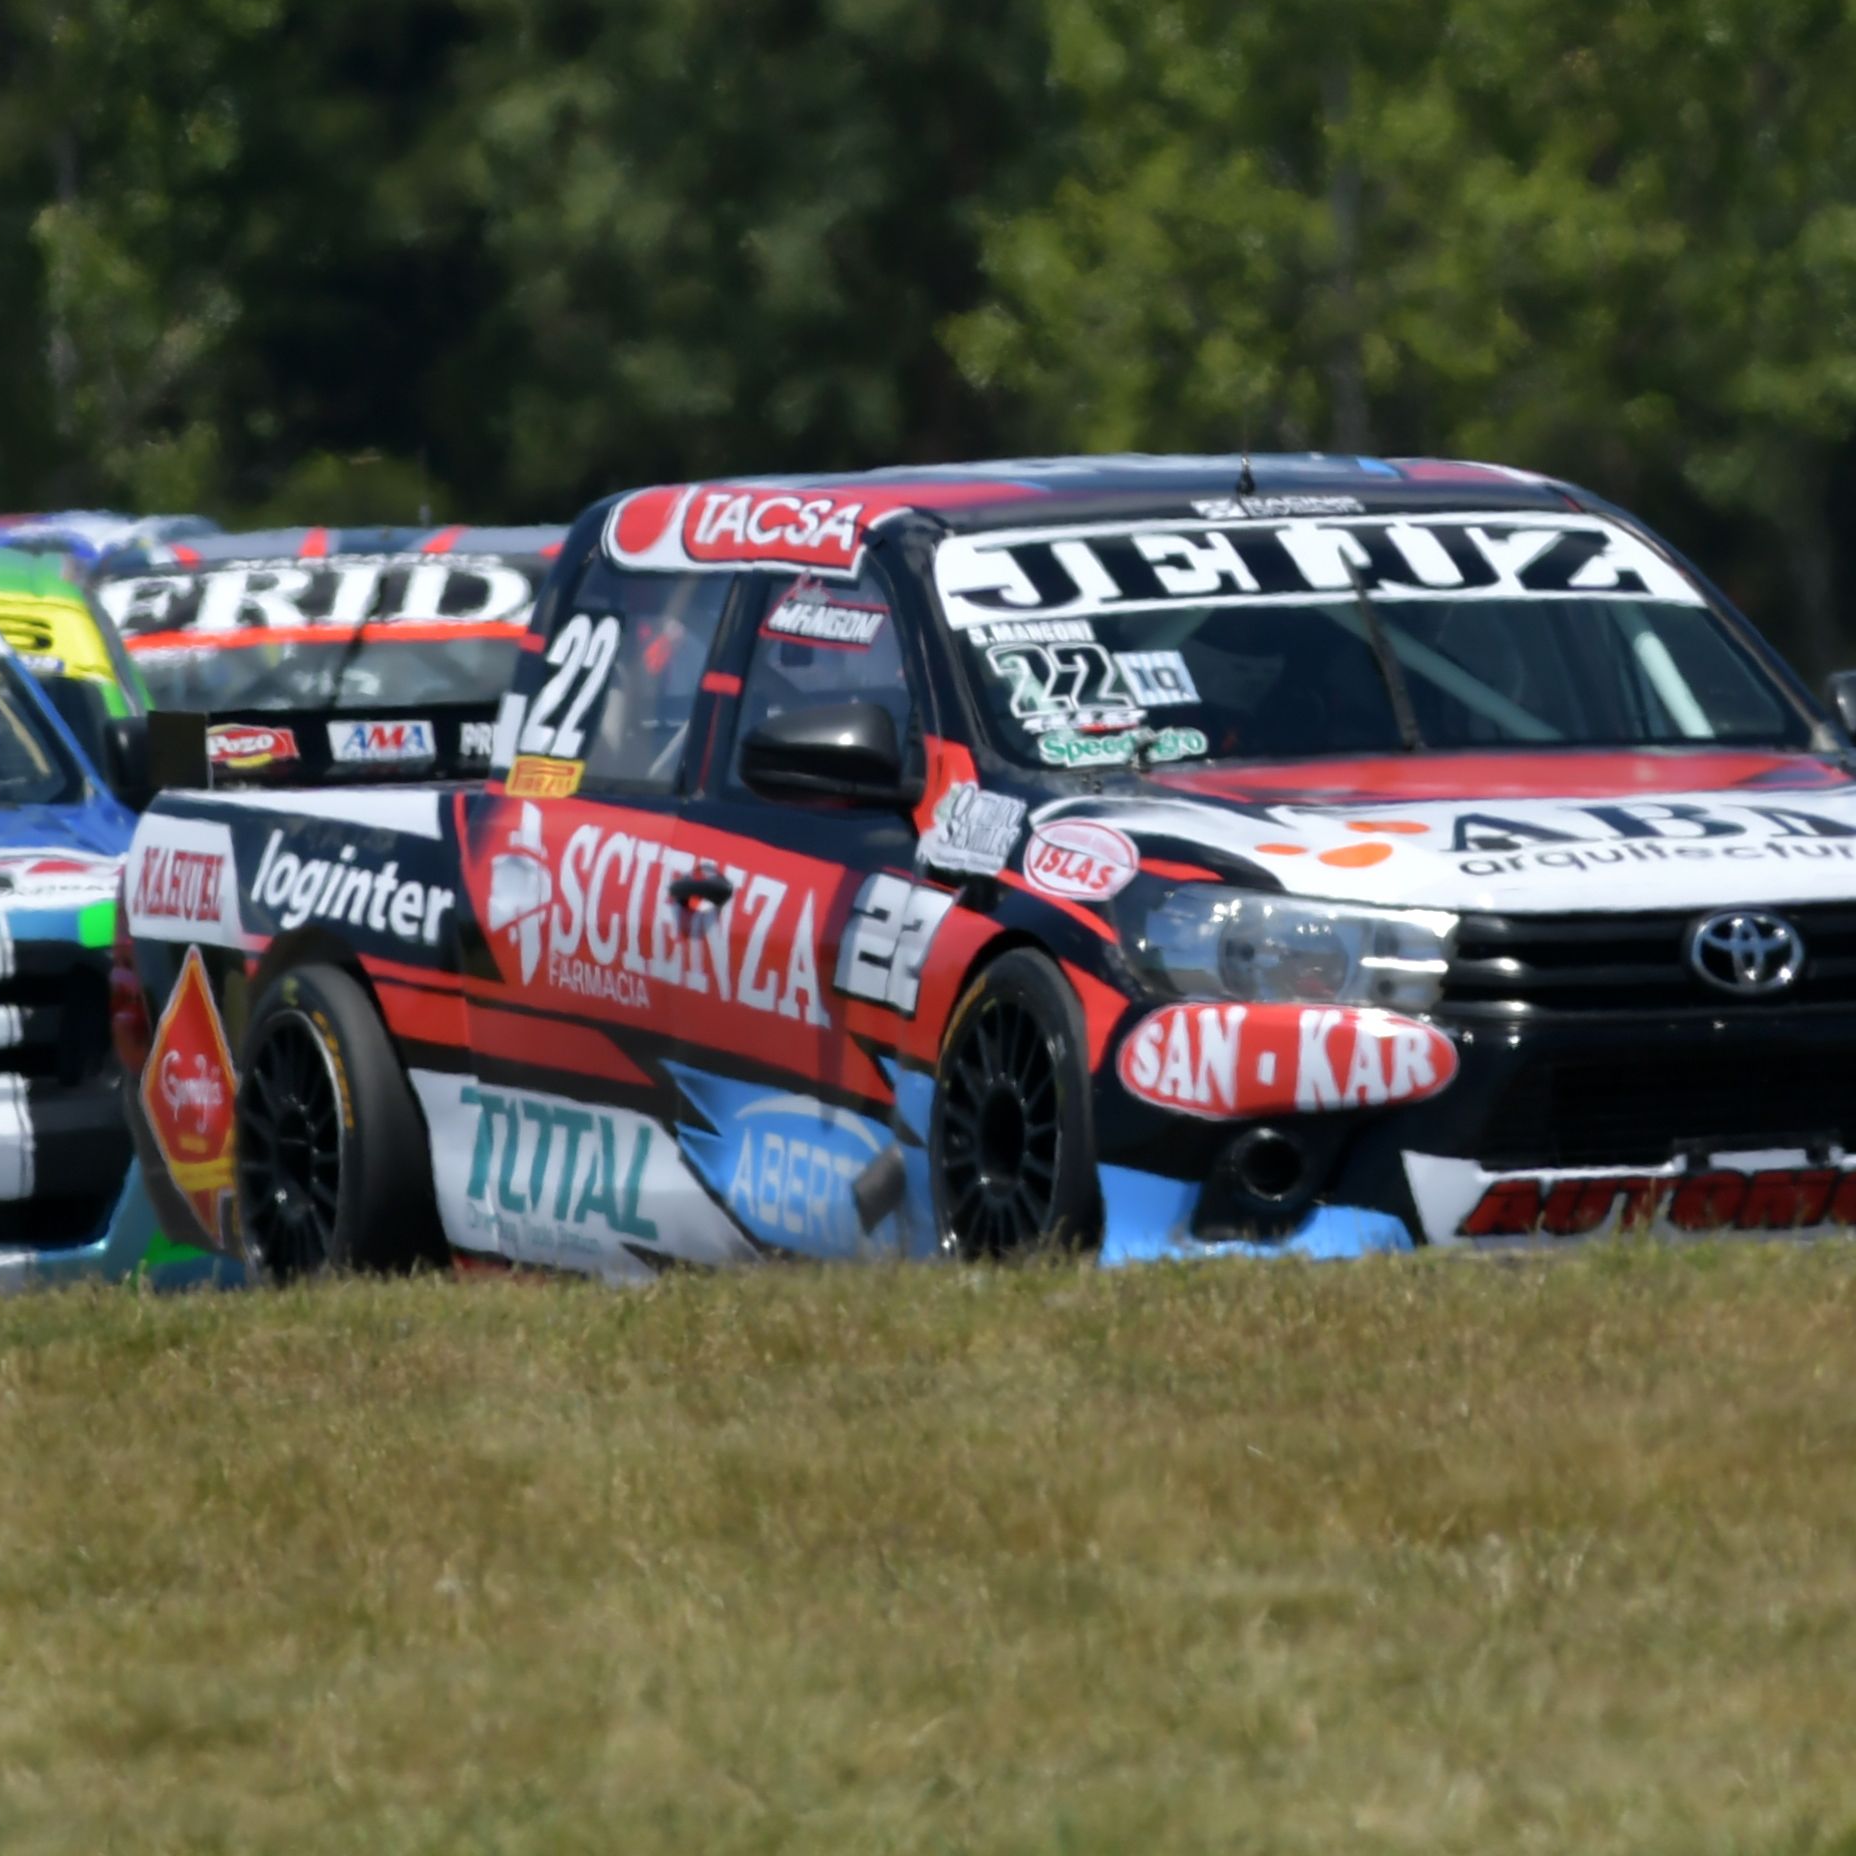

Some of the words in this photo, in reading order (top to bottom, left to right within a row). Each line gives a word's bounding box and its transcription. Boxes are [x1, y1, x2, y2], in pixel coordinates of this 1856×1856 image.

[694, 494, 863, 550] TACSA
[519, 613, 620, 758] 22
[986, 643, 1138, 719] 22
[345, 722, 426, 749] AMA
[250, 828, 456, 945] loginter
[1034, 843, 1117, 891] ISLAS
[548, 823, 832, 1030] SCIENZA
[833, 871, 955, 1018] 22
[548, 955, 650, 1010] FARMACIA
